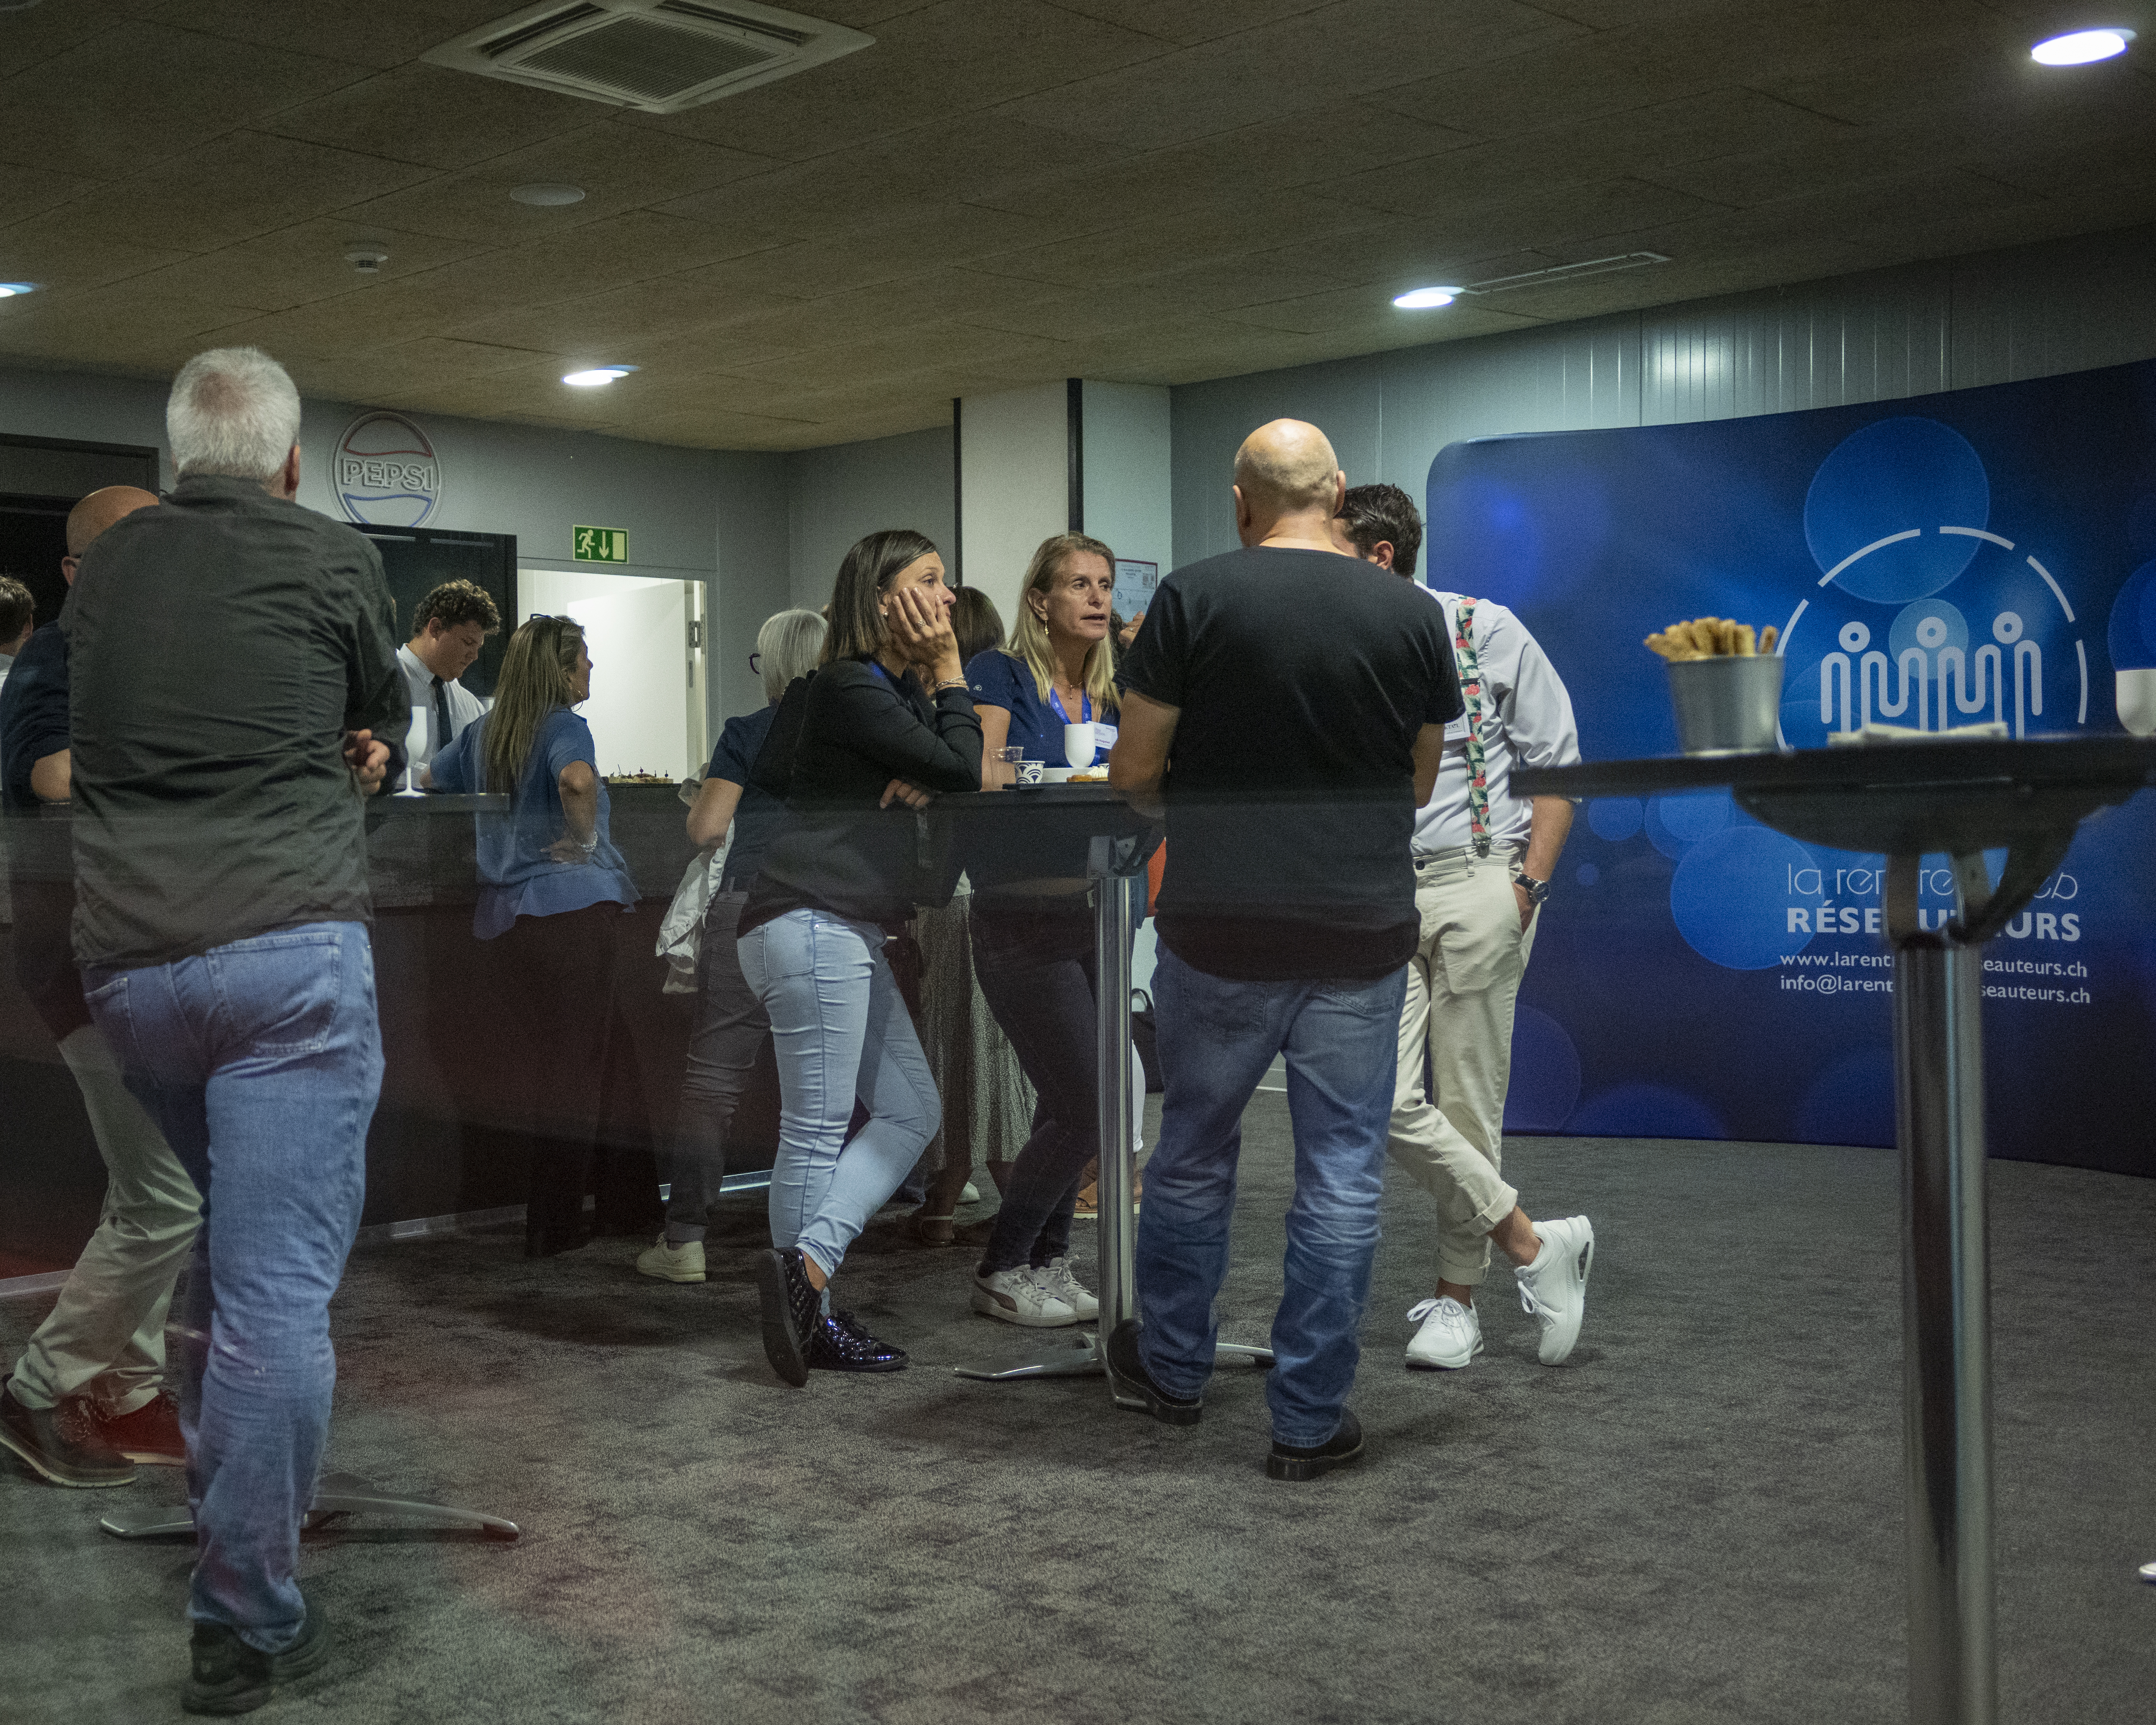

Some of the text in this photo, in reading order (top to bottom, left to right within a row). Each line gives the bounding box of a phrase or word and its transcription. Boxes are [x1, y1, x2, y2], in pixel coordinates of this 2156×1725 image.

[341, 459, 432, 491] PEPSI
[1789, 863, 1821, 895] la
[1787, 900, 2081, 942] RÉSEUURS
[1780, 951, 2087, 977] www.larenteauteurs.ch
[1781, 974, 2090, 1003] info@larentseauteurs.ch
